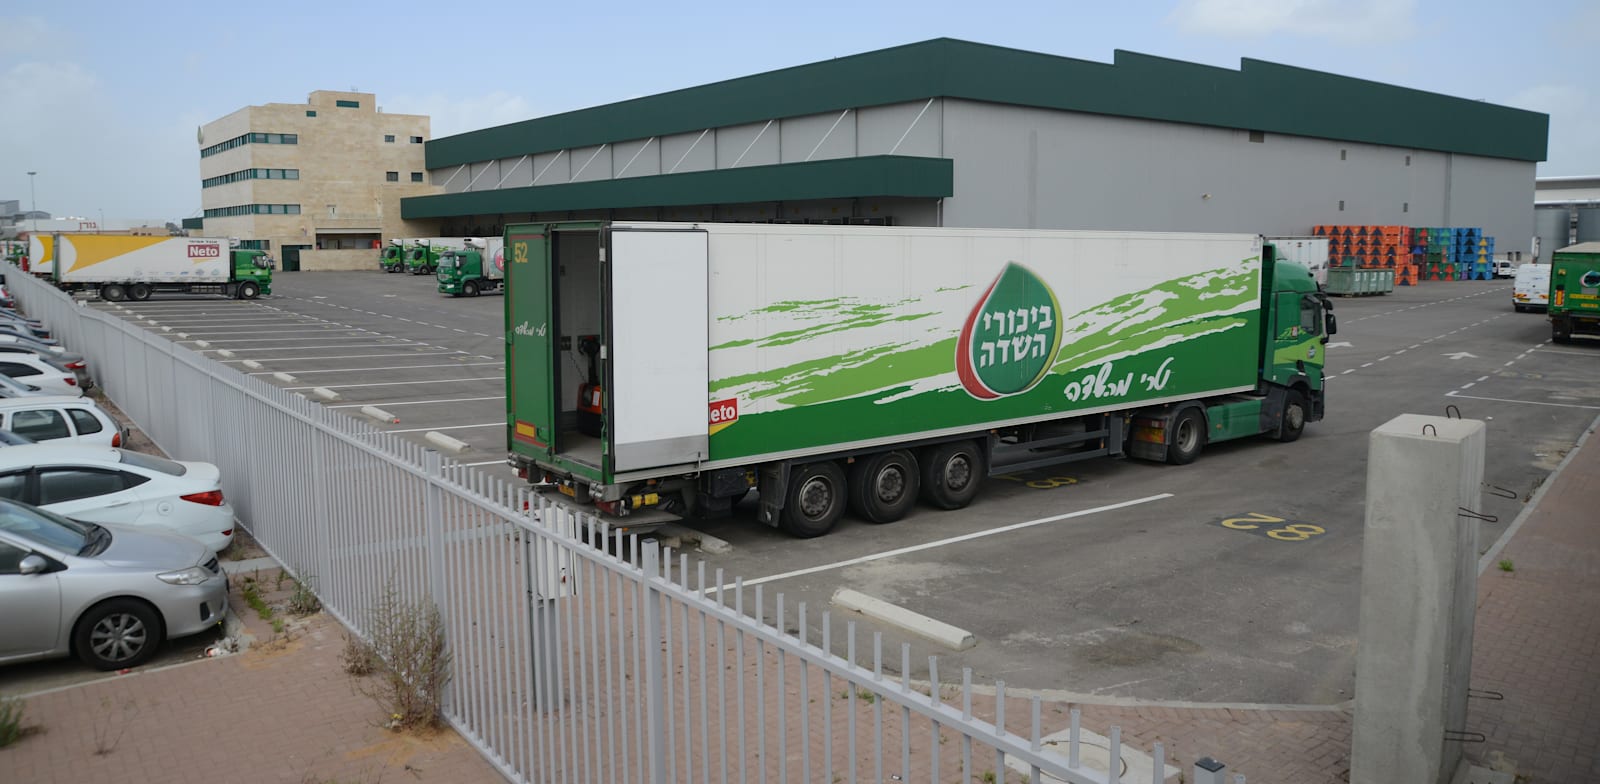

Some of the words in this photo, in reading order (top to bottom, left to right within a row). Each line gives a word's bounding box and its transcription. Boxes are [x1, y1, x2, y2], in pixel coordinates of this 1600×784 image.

[190, 246, 218, 256] Neto
[514, 242, 528, 263] 52
[983, 304, 1053, 338] ביכורי
[980, 333, 1048, 369] השדה
[1064, 361, 1134, 402] מהשדה
[1140, 357, 1175, 391] טרי
[709, 404, 736, 422] eto
